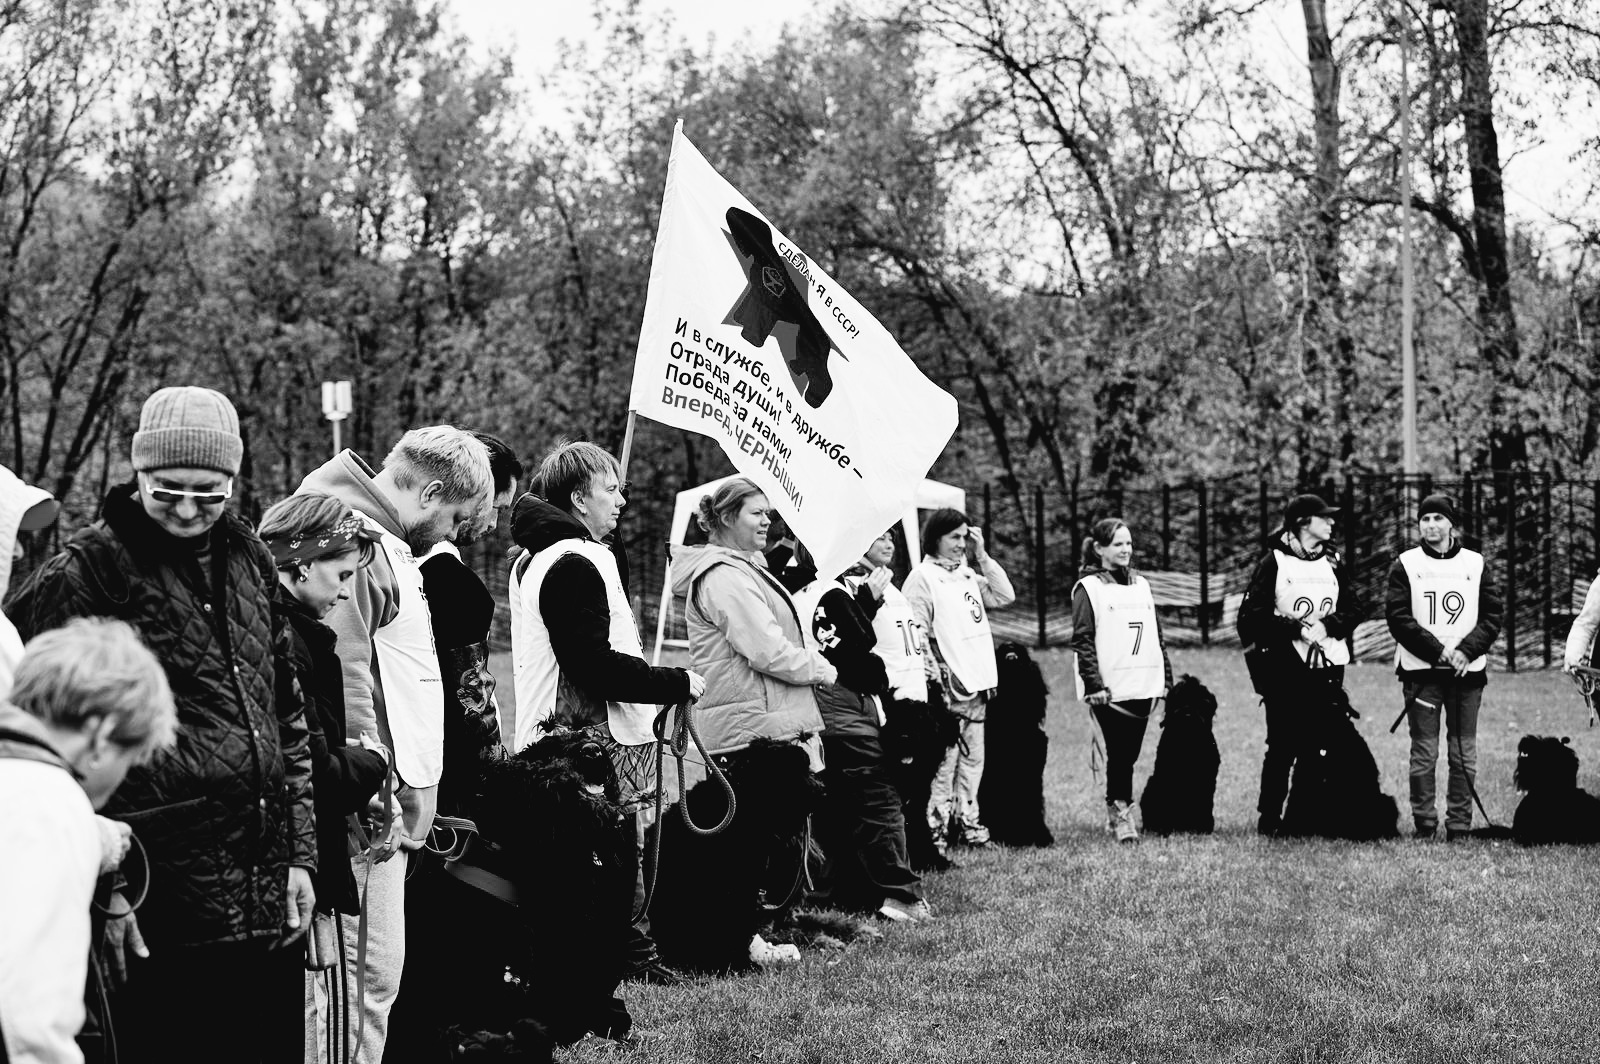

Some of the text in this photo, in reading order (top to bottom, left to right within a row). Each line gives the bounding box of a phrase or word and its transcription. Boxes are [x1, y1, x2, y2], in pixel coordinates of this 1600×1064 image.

[778, 242, 860, 339] СДЕЛАН Я В СССР!
[665, 363, 792, 464] Победа за нами!
[670, 341, 782, 426] Отрада души!
[674, 317, 688, 338] И
[693, 329, 701, 343] в
[705, 337, 772, 392] службе,
[776, 386, 784, 403] и
[785, 399, 792, 414] в
[791, 412, 851, 469] дружбе
[895, 619, 922, 656] 10
[963, 591, 983, 623] 3
[1423, 590, 1465, 625] 19
[1128, 621, 1144, 656] 7
